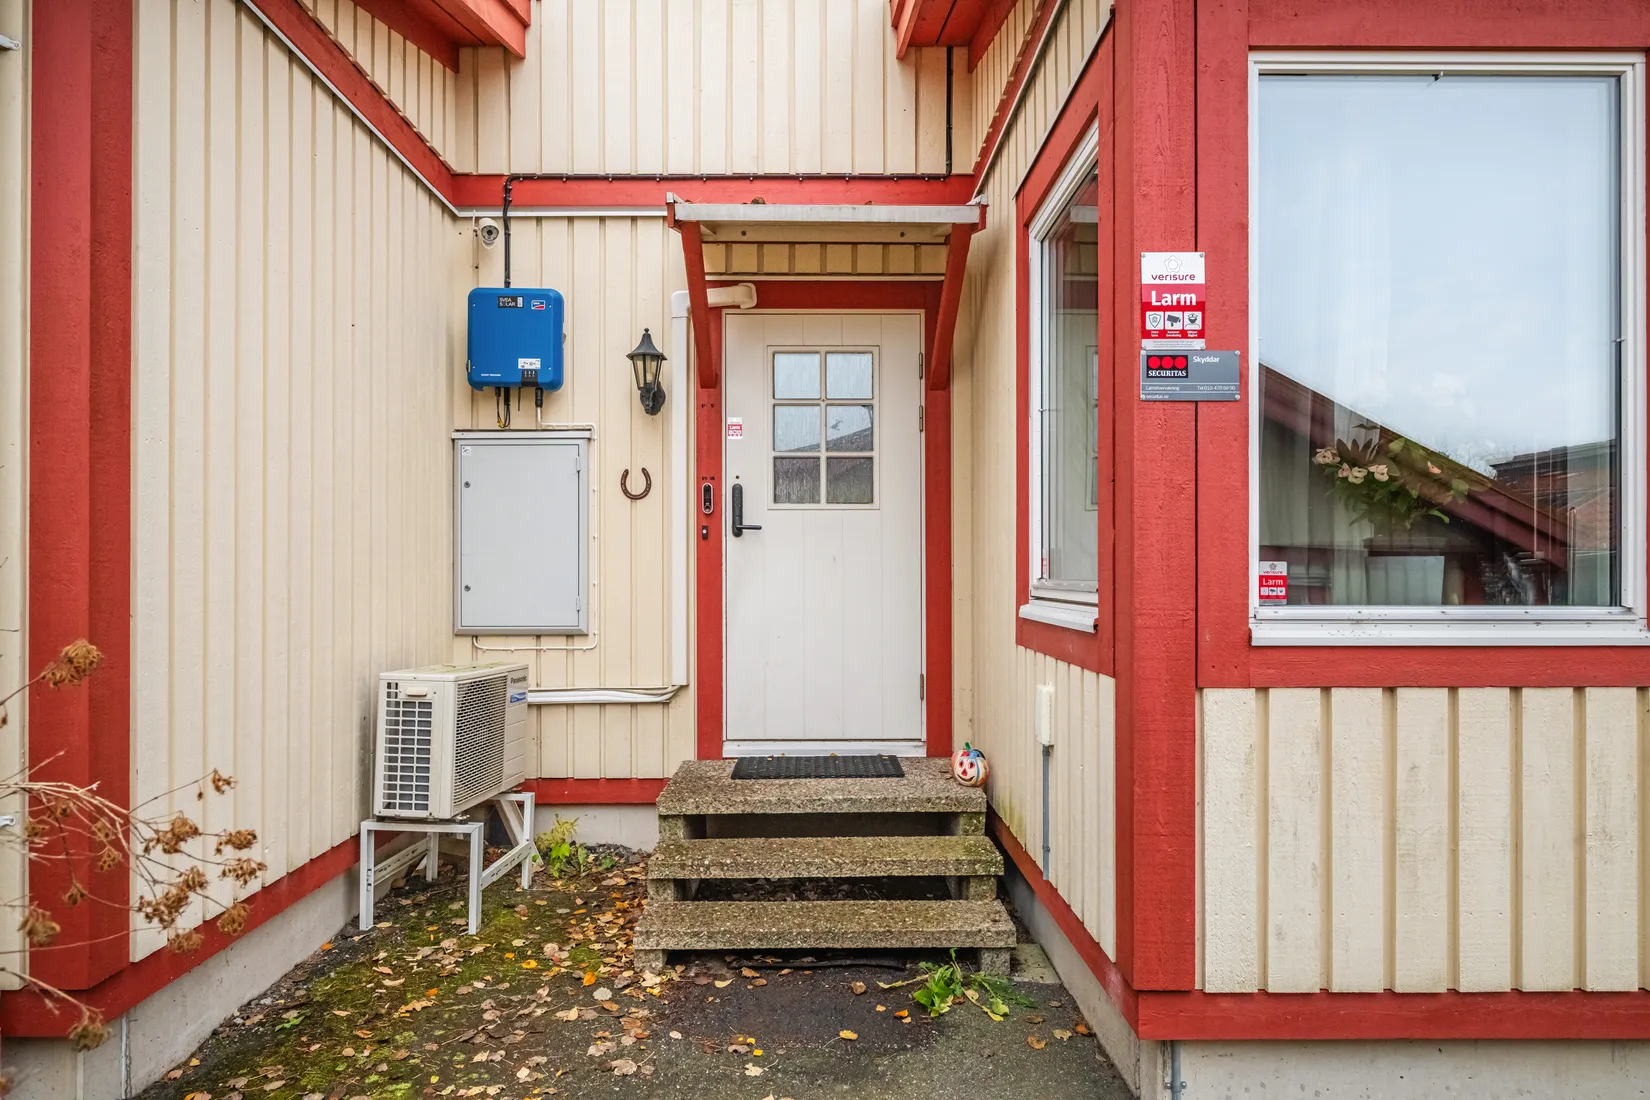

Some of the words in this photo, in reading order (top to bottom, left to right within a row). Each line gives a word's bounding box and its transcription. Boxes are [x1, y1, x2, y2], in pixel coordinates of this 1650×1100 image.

[1151, 290, 1197, 306] Larm
[1192, 355, 1220, 363] Skyddar
[1262, 578, 1284, 586] Larm
